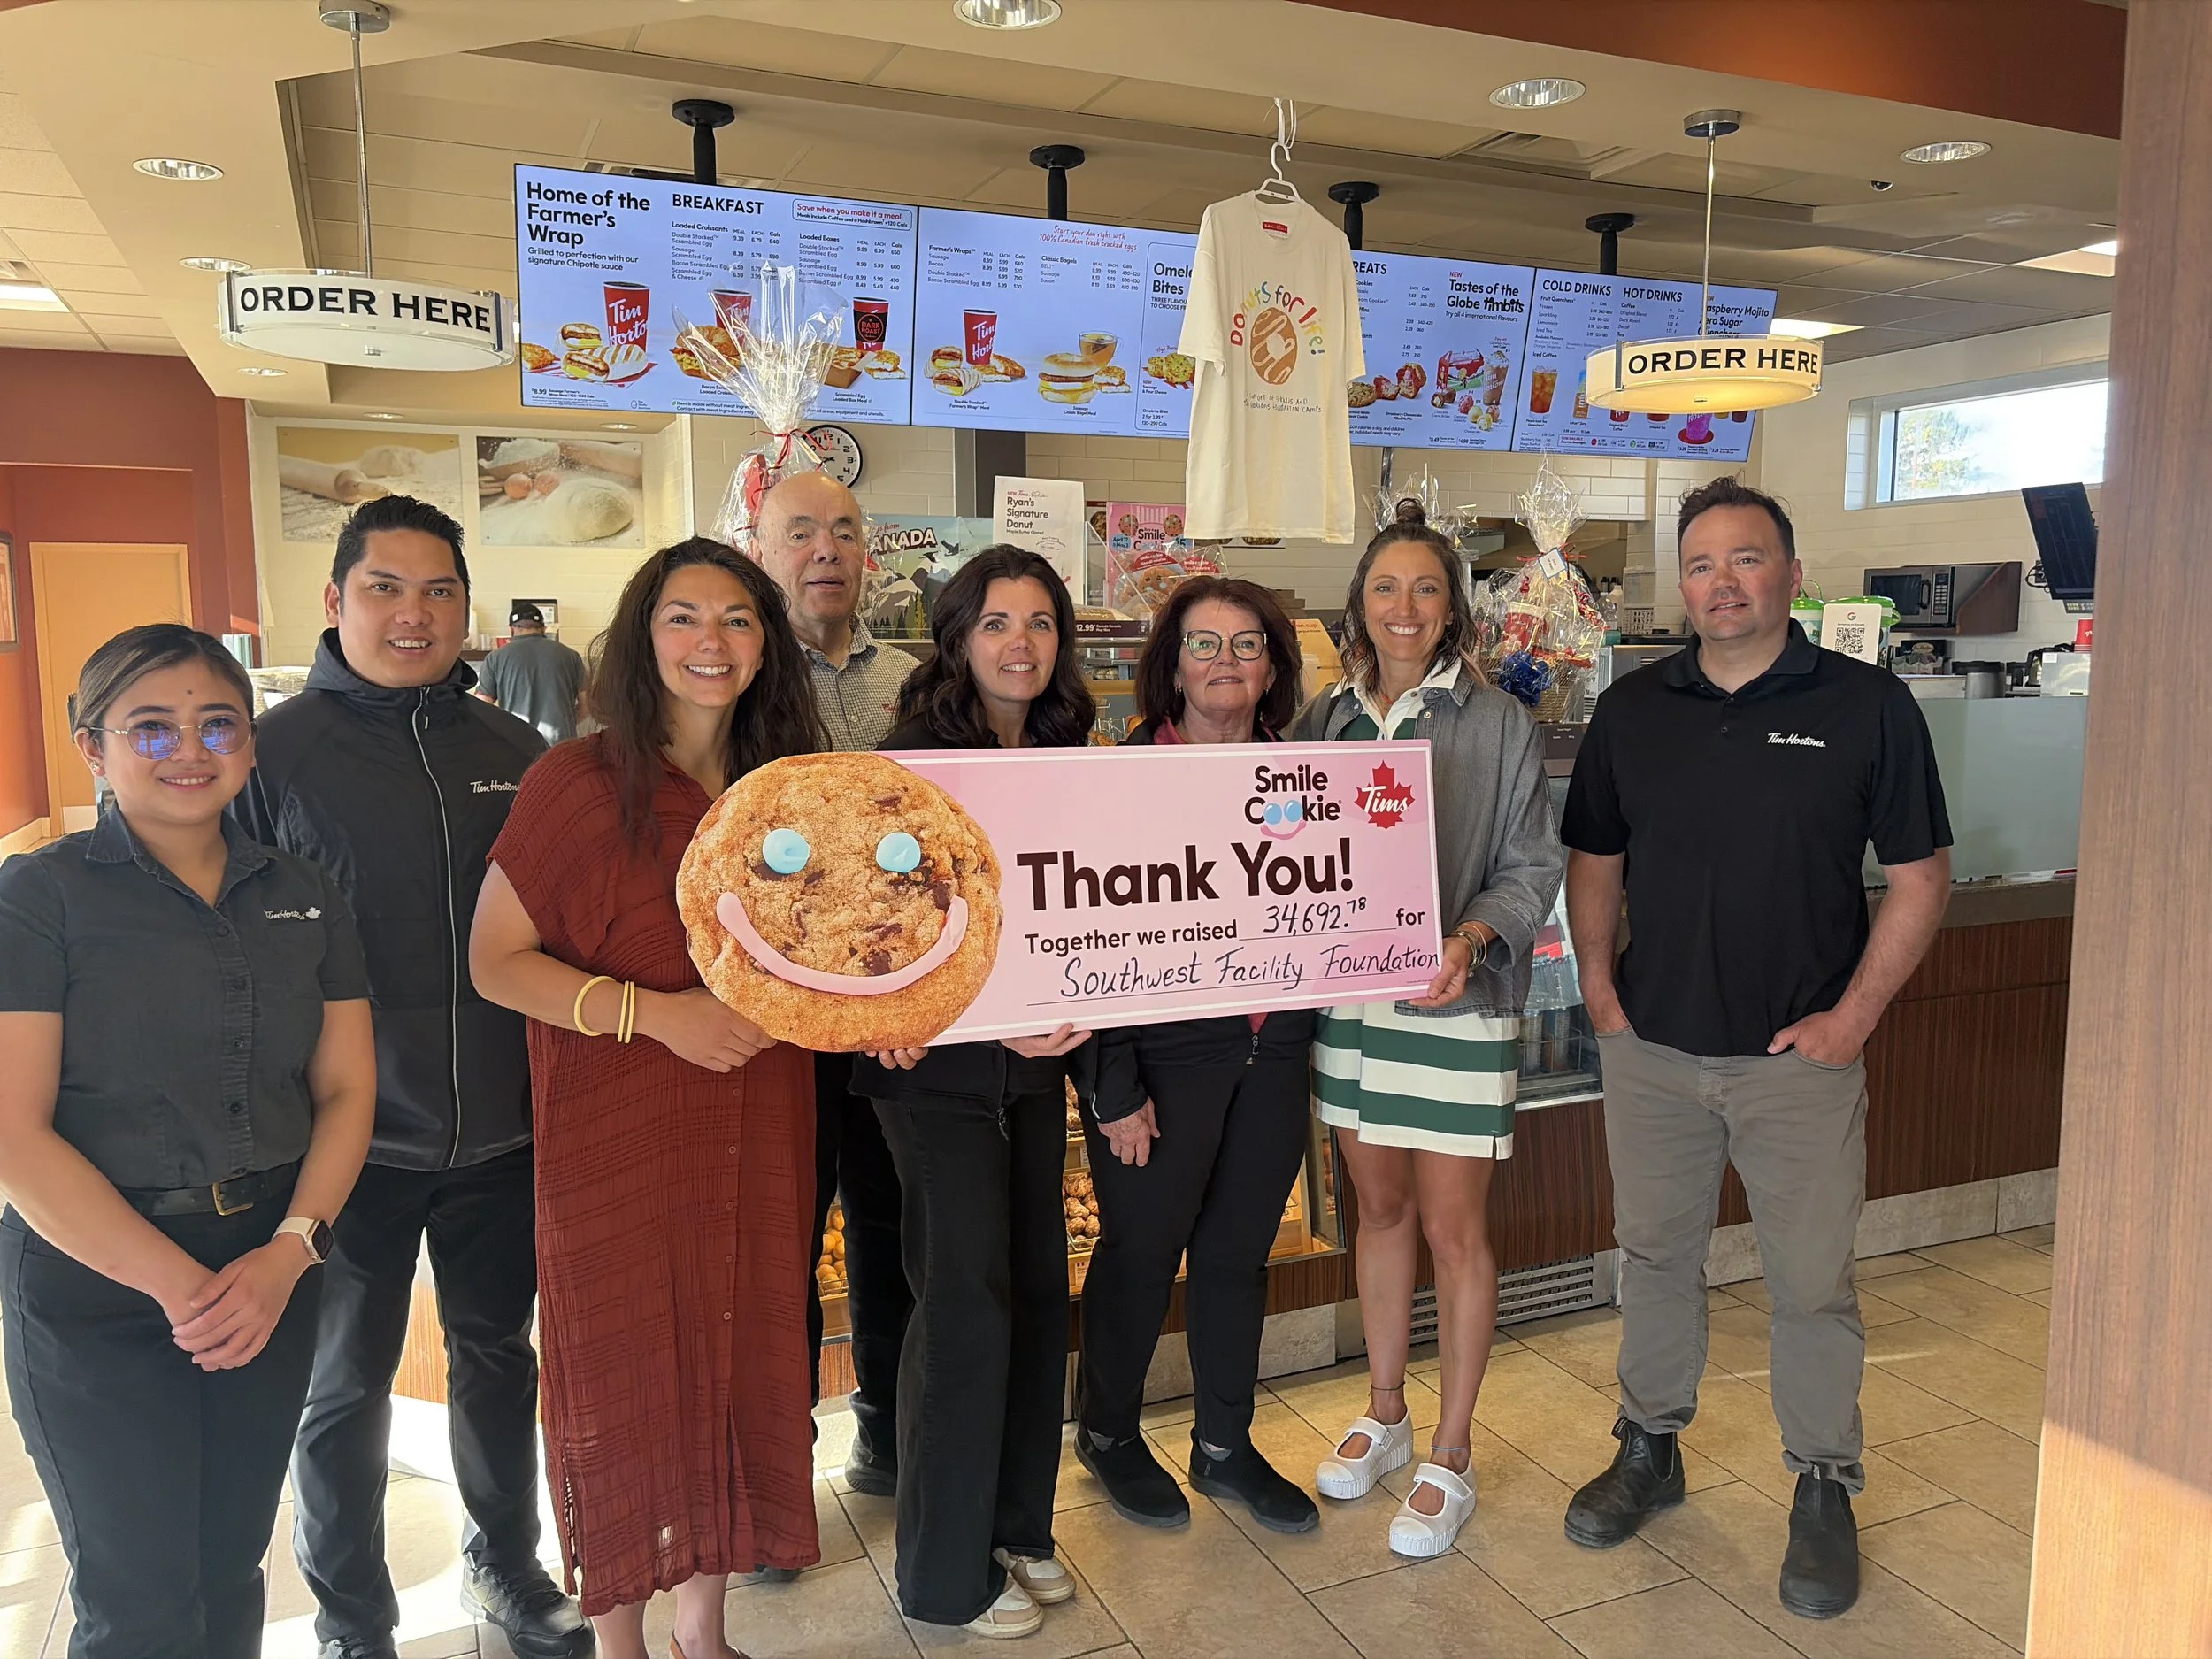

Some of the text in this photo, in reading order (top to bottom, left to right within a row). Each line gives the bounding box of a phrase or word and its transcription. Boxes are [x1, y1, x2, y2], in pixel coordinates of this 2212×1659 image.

[527, 182, 650, 211] Home of the
[672, 194, 764, 214] BREAKFAST
[527, 203, 616, 227] Farmer's
[527, 224, 583, 249] Wrap
[1040, 234, 1056, 242] 100%
[1102, 240, 1122, 249] cracked
[1086, 229, 1095, 239] day
[1097, 231, 1110, 241] right
[527, 247, 554, 256] Grilled
[566, 250, 606, 260] perfection
[528, 257, 565, 265] signature
[567, 259, 600, 269] Chipotle
[1353, 261, 1387, 274] REATS
[1153, 280, 1184, 295] Bites
[1449, 279, 1518, 296] Tastes of the
[1542, 280, 1611, 296] COLD DRINKS
[1624, 287, 1682, 302] HOT DRINKS
[1275, 285, 1304, 312] for
[1447, 296, 1479, 309] Globe
[241, 286, 491, 333] ORDER HERE
[609, 299, 641, 324] Tim
[1707, 304, 1769, 319] aspberry Mojito
[1719, 317, 1743, 328] Sugar
[972, 321, 995, 341] Tim
[1628, 348, 1818, 374] ORDER HERE
[1007, 496, 1034, 507] Ryan's
[1007, 508, 1048, 518] Signature
[1006, 519, 1033, 528] Donut
[870, 527, 938, 557] ANADA
[1138, 529, 1165, 540] Smile
[1768, 733, 1786, 743] Tim
[470, 780, 490, 793] Tim
[1255, 764, 1328, 793] Smile
[1360, 786, 1409, 814] Tims
[1016, 837, 1354, 911] Thank You!
[1025, 927, 1130, 956] Together
[1138, 928, 1166, 945] we
[1172, 919, 1238, 944] raised
[1396, 908, 1425, 927] for
[1060, 942, 1440, 998] Southwest Facility Foundation
